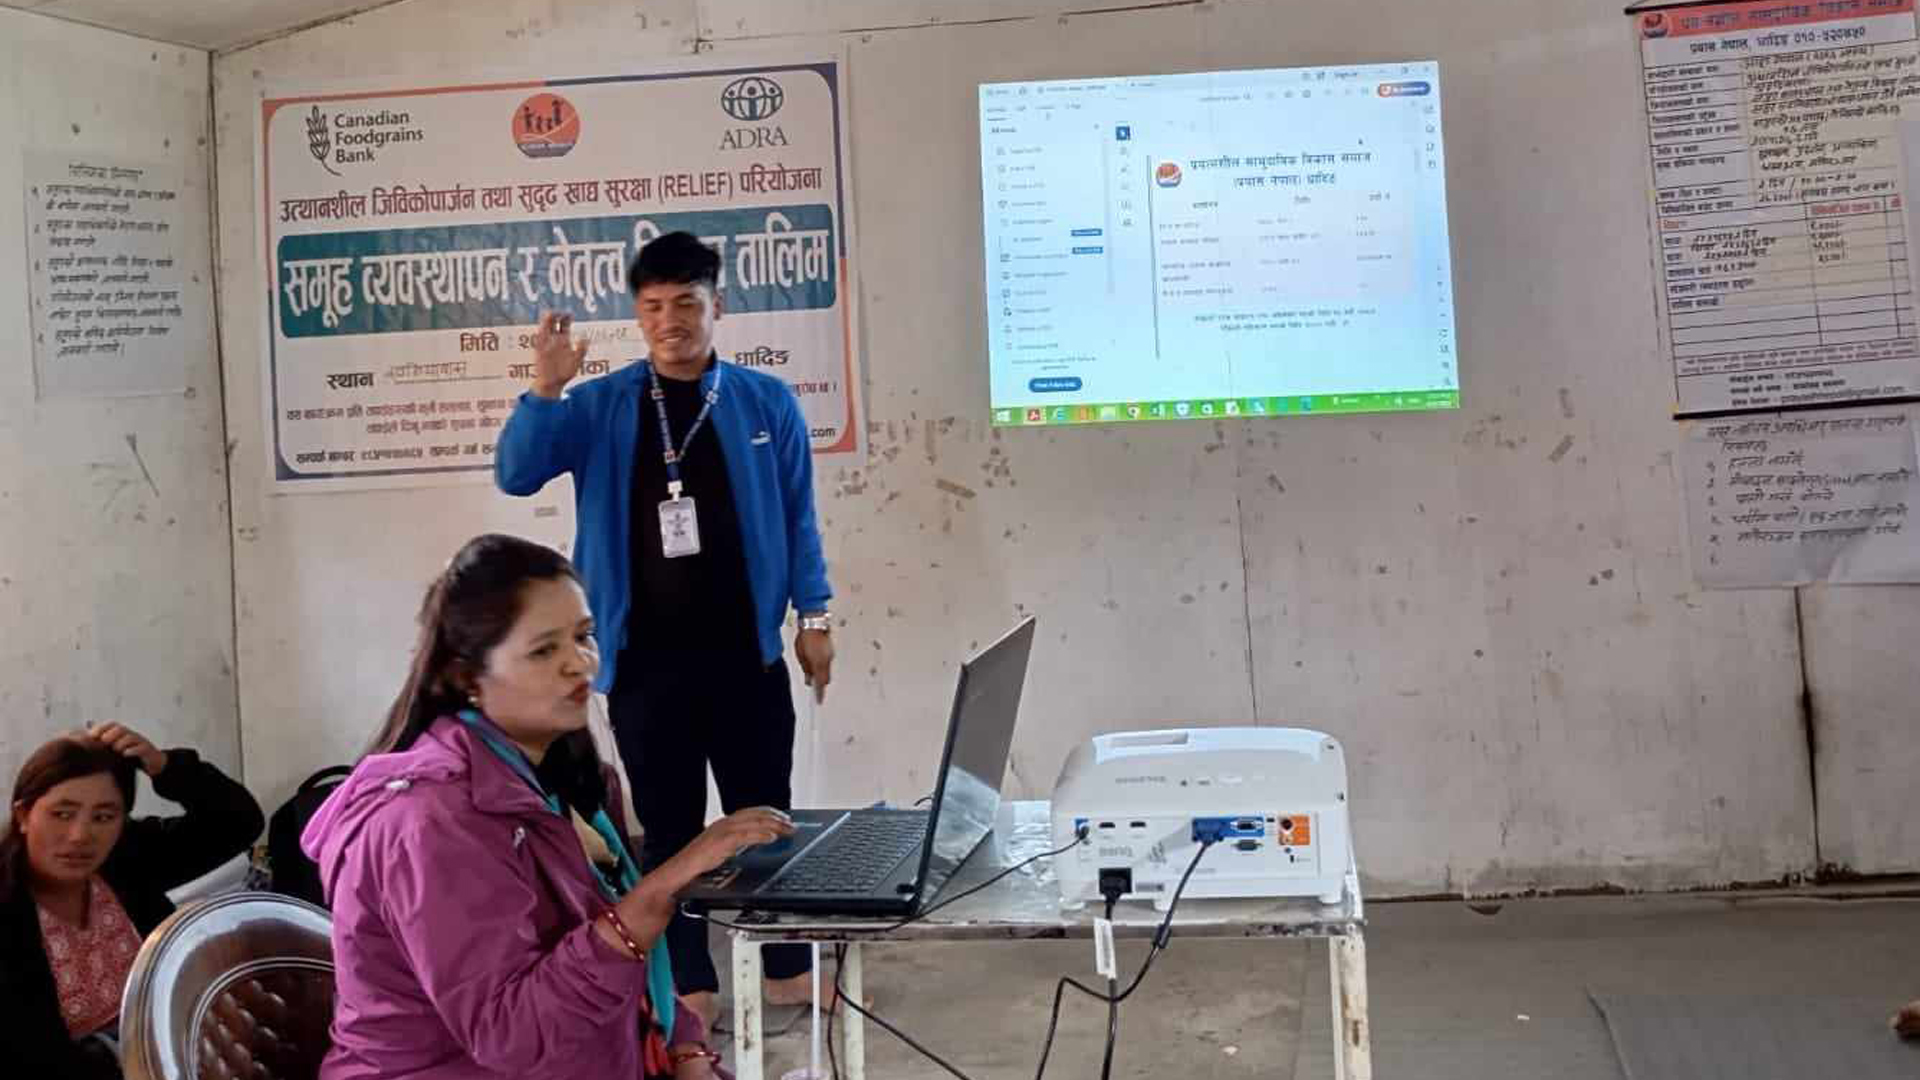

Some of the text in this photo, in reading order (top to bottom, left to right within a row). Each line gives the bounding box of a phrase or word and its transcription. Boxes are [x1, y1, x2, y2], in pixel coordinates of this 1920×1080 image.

[334, 110, 410, 128] Canadian
[335, 128, 424, 148] Foodgrains
[719, 127, 790, 150] ADRA
[335, 147, 375, 163] Bank
[280, 163, 822, 222] उत्थानशील जिविकोपार्जन तथा सुदृढ खाद्य सुरक्षा (RELIEF) परियोजना
[283, 257, 353, 328] समूह
[361, 247, 509, 310] व्यवस्थापन
[517, 247, 539, 301] र
[546, 225, 627, 313] नेतृत्व
[735, 212, 829, 289] तालिम
[460, 331, 499, 351] मिति
[735, 346, 791, 367] धादिङ
[326, 371, 374, 390] स्थान
